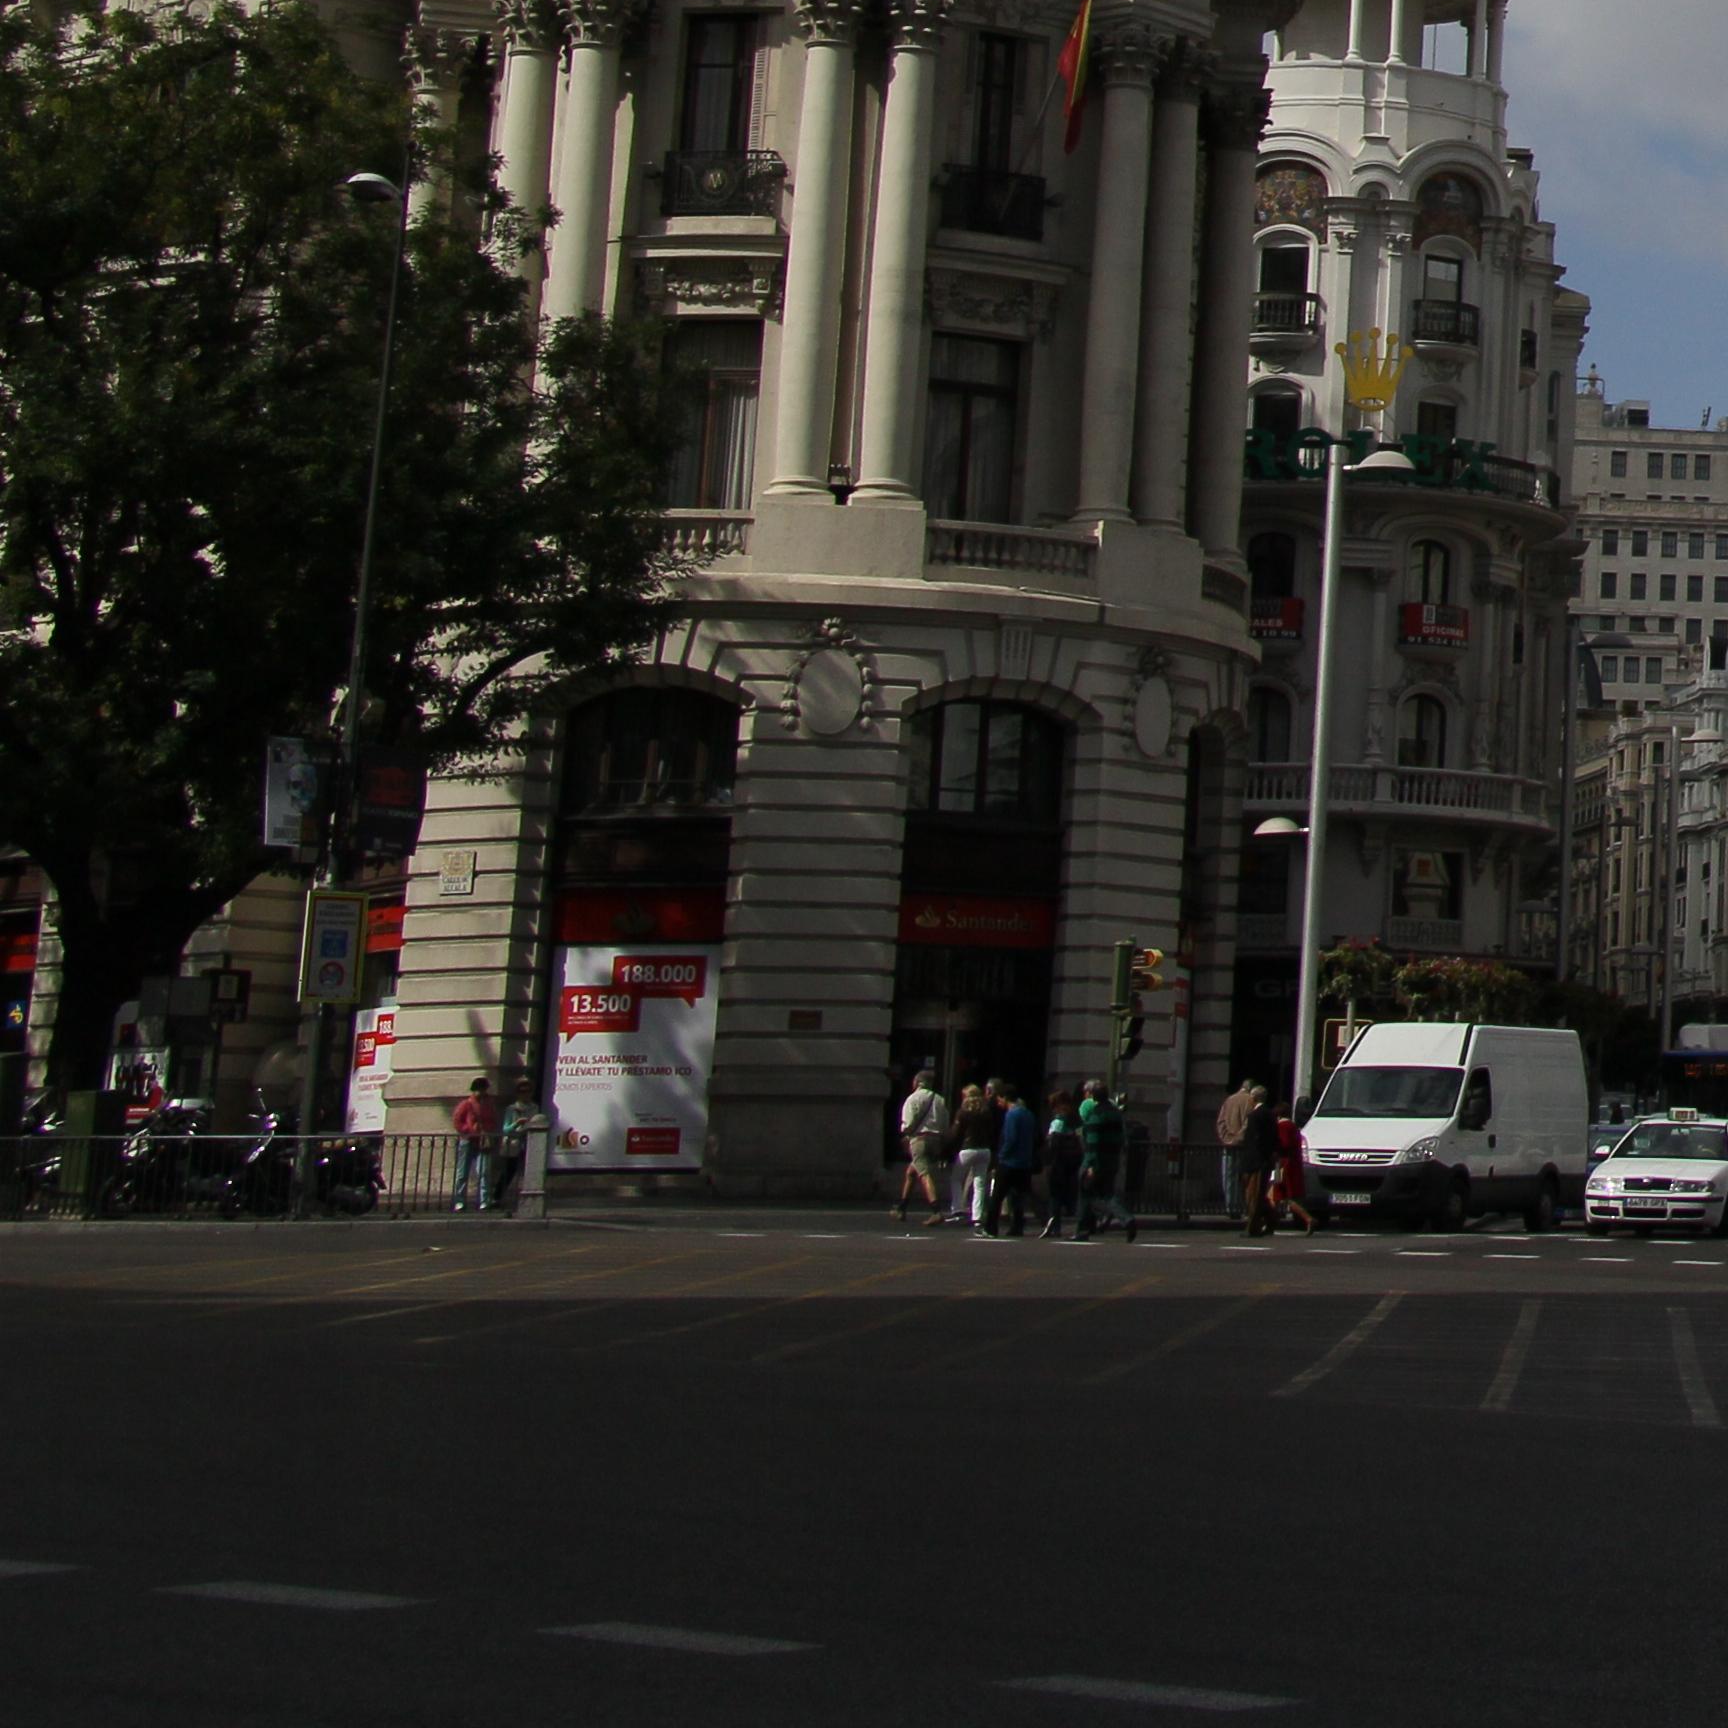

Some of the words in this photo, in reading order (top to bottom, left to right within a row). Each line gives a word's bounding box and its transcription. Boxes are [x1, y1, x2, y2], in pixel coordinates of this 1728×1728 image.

[1246, 427, 1499, 491] ROLEX
[945, 909, 1034, 932] Santander
[621, 964, 697, 983] 188.000
[570, 994, 631, 1013] 13.500
[559, 1055, 576, 1064] VEN
[578, 1055, 589, 1064] AL
[592, 1055, 647, 1064] SANTANDER
[607, 1067, 618, 1076] TU
